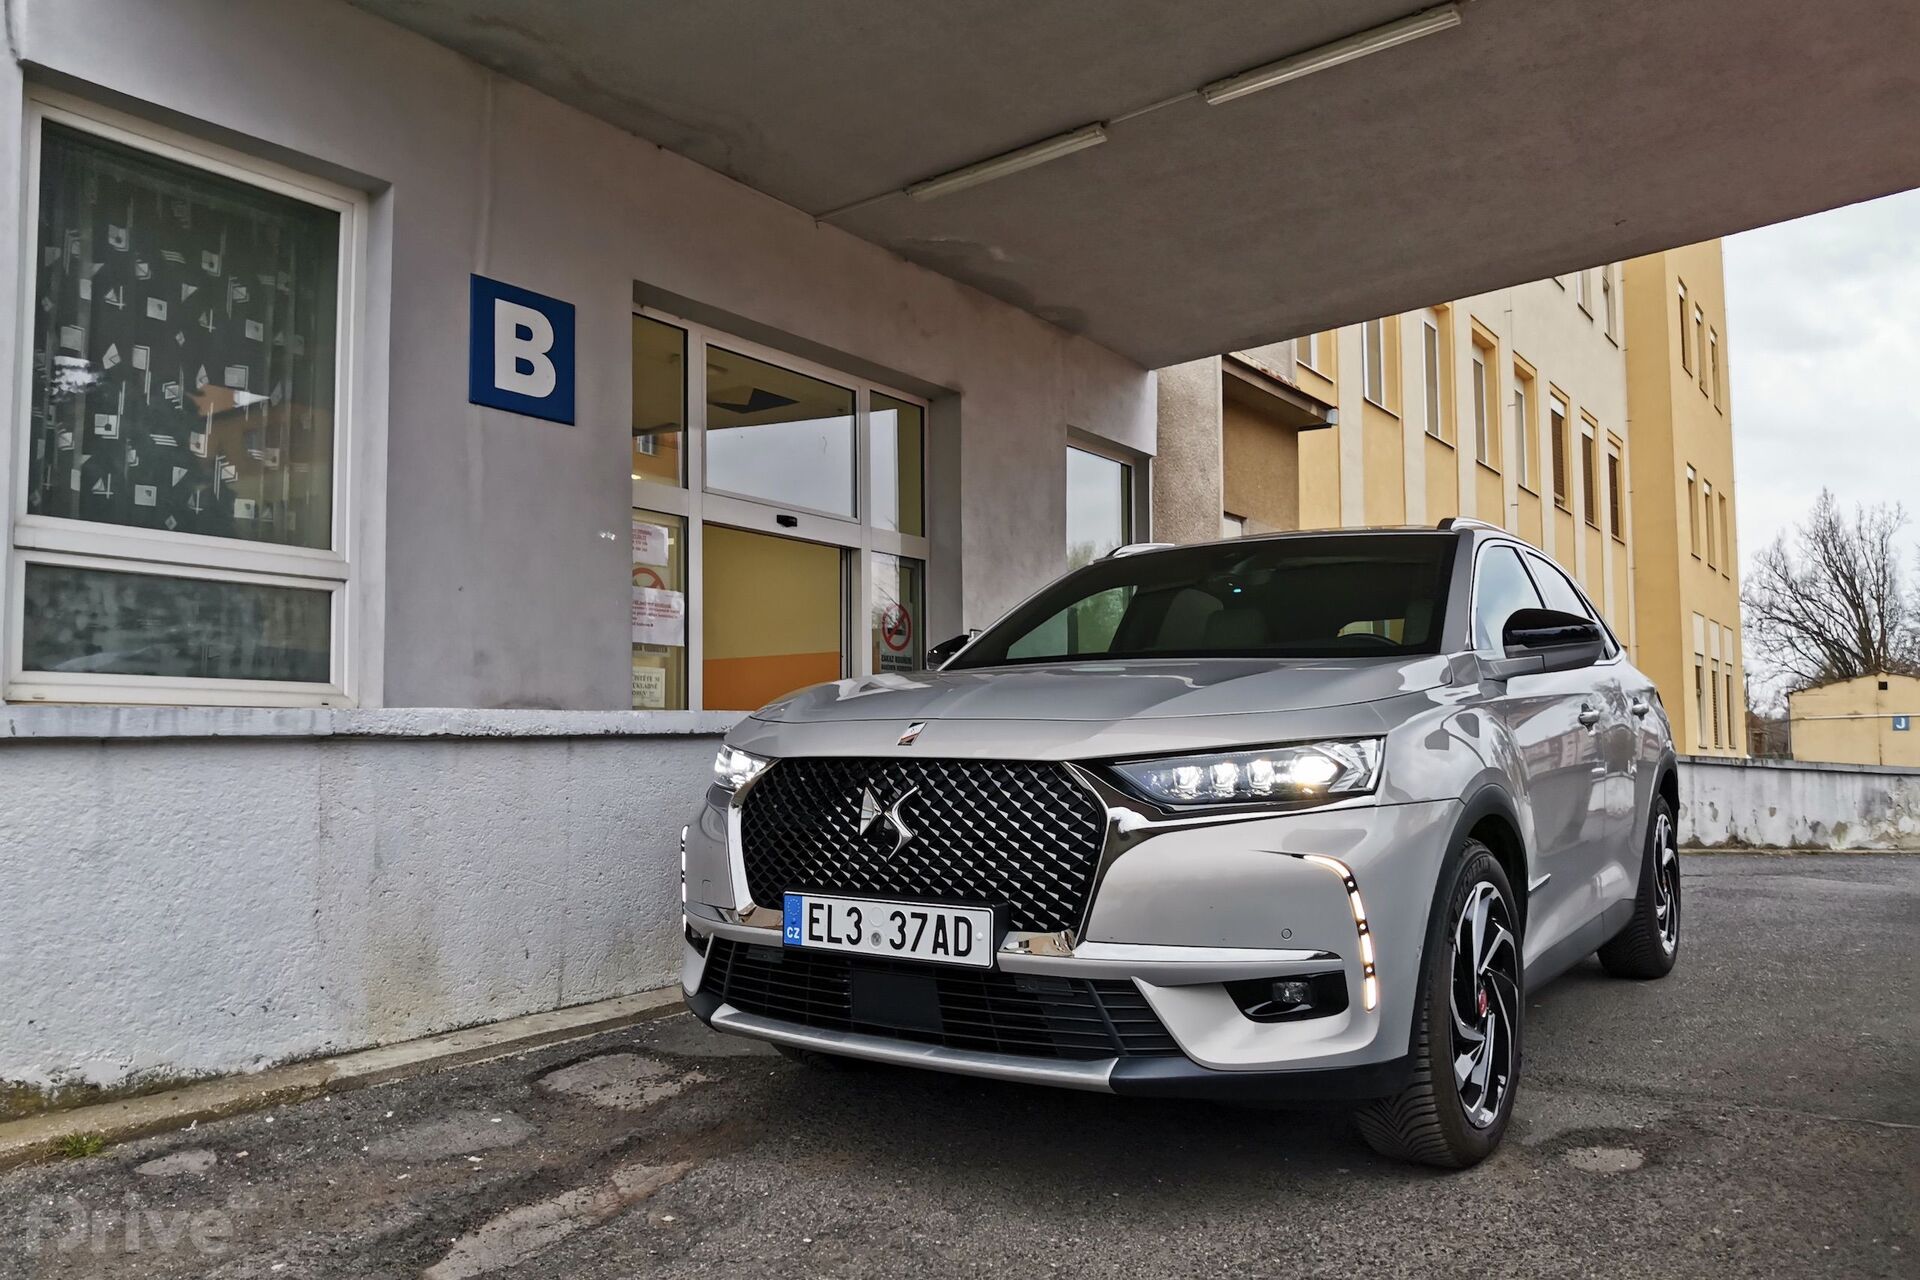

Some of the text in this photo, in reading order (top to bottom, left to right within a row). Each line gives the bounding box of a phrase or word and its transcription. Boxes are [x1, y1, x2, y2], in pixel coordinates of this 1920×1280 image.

[494, 298, 557, 398] B
[1895, 717, 1906, 729] J
[786, 926, 800, 939] CZ
[808, 902, 973, 957] EL3 37AD
